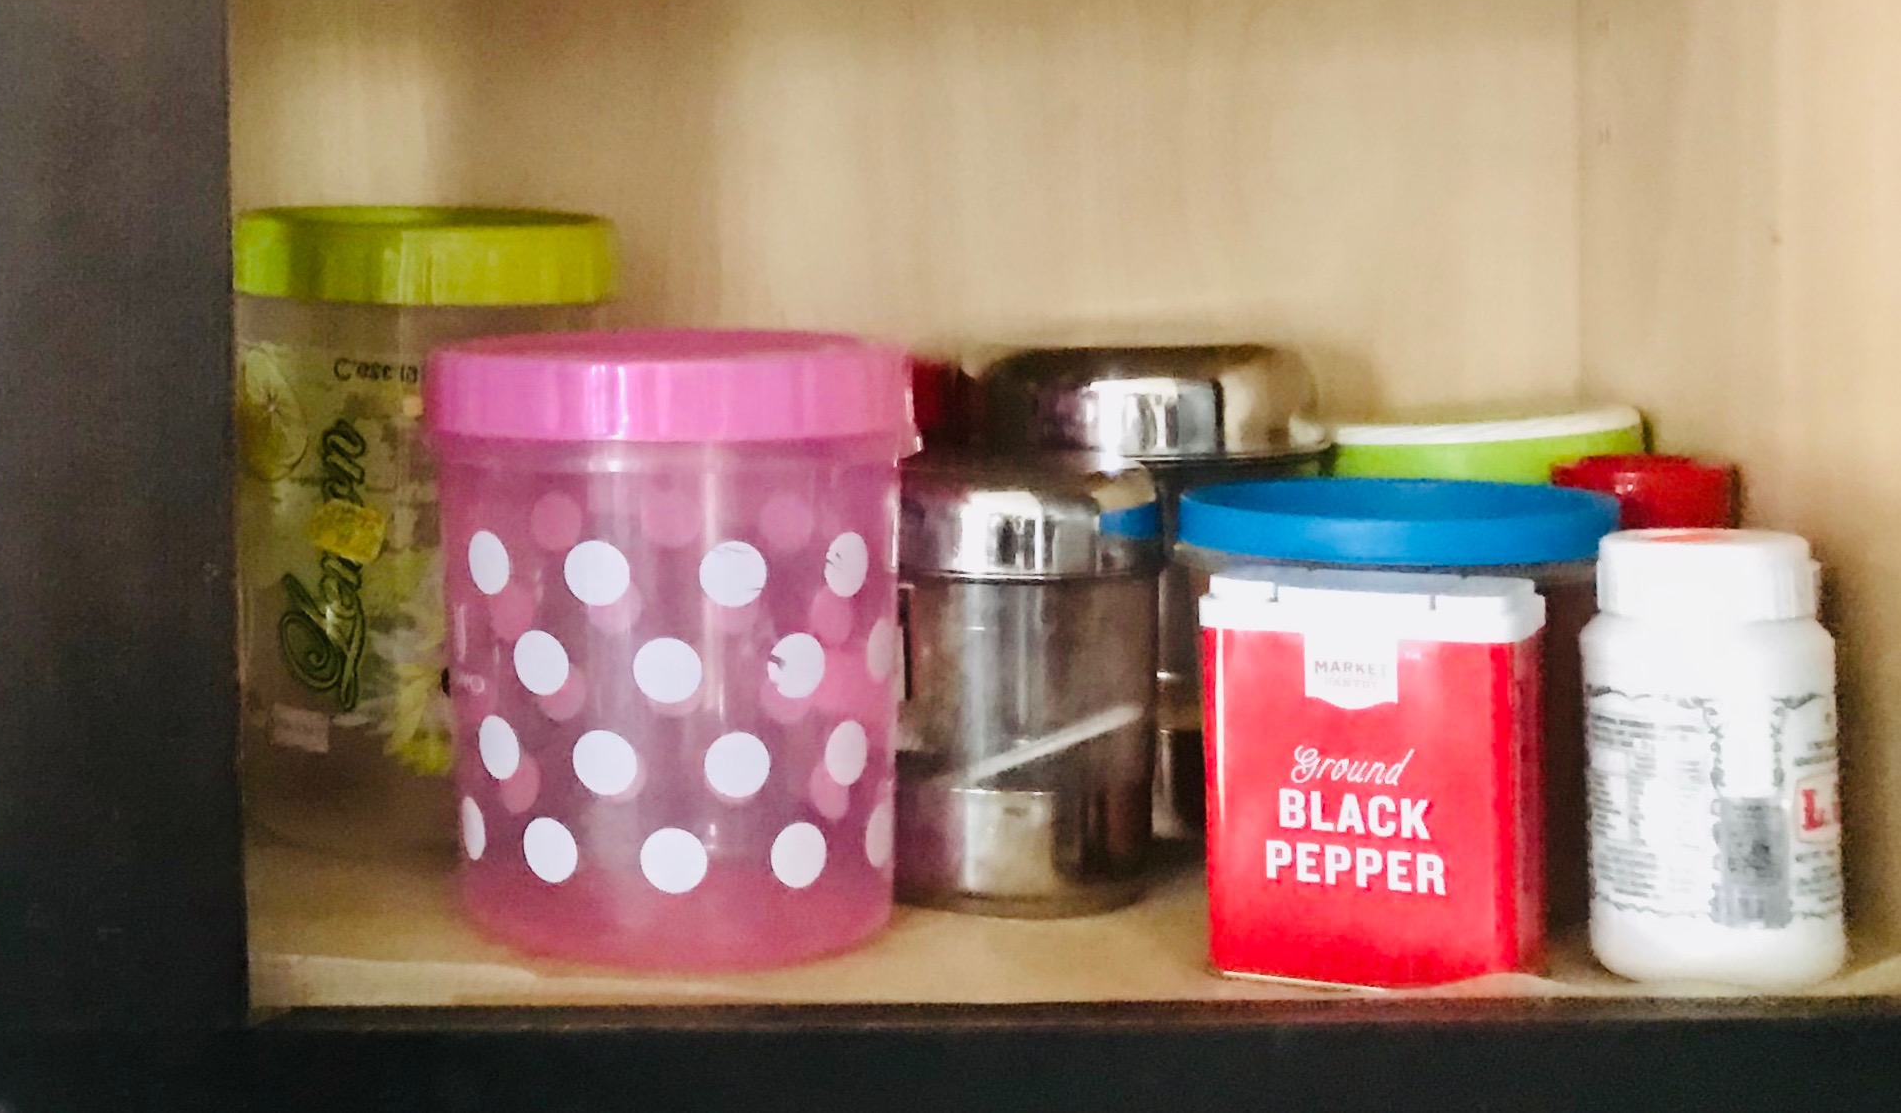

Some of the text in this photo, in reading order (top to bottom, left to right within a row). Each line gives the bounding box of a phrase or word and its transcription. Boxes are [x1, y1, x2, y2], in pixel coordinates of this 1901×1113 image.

[1314, 660, 1388, 678] MARKET
[1290, 744, 1415, 786] Ground
[1278, 787, 1431, 840] BLACK
[1265, 839, 1447, 896] PEPPER
